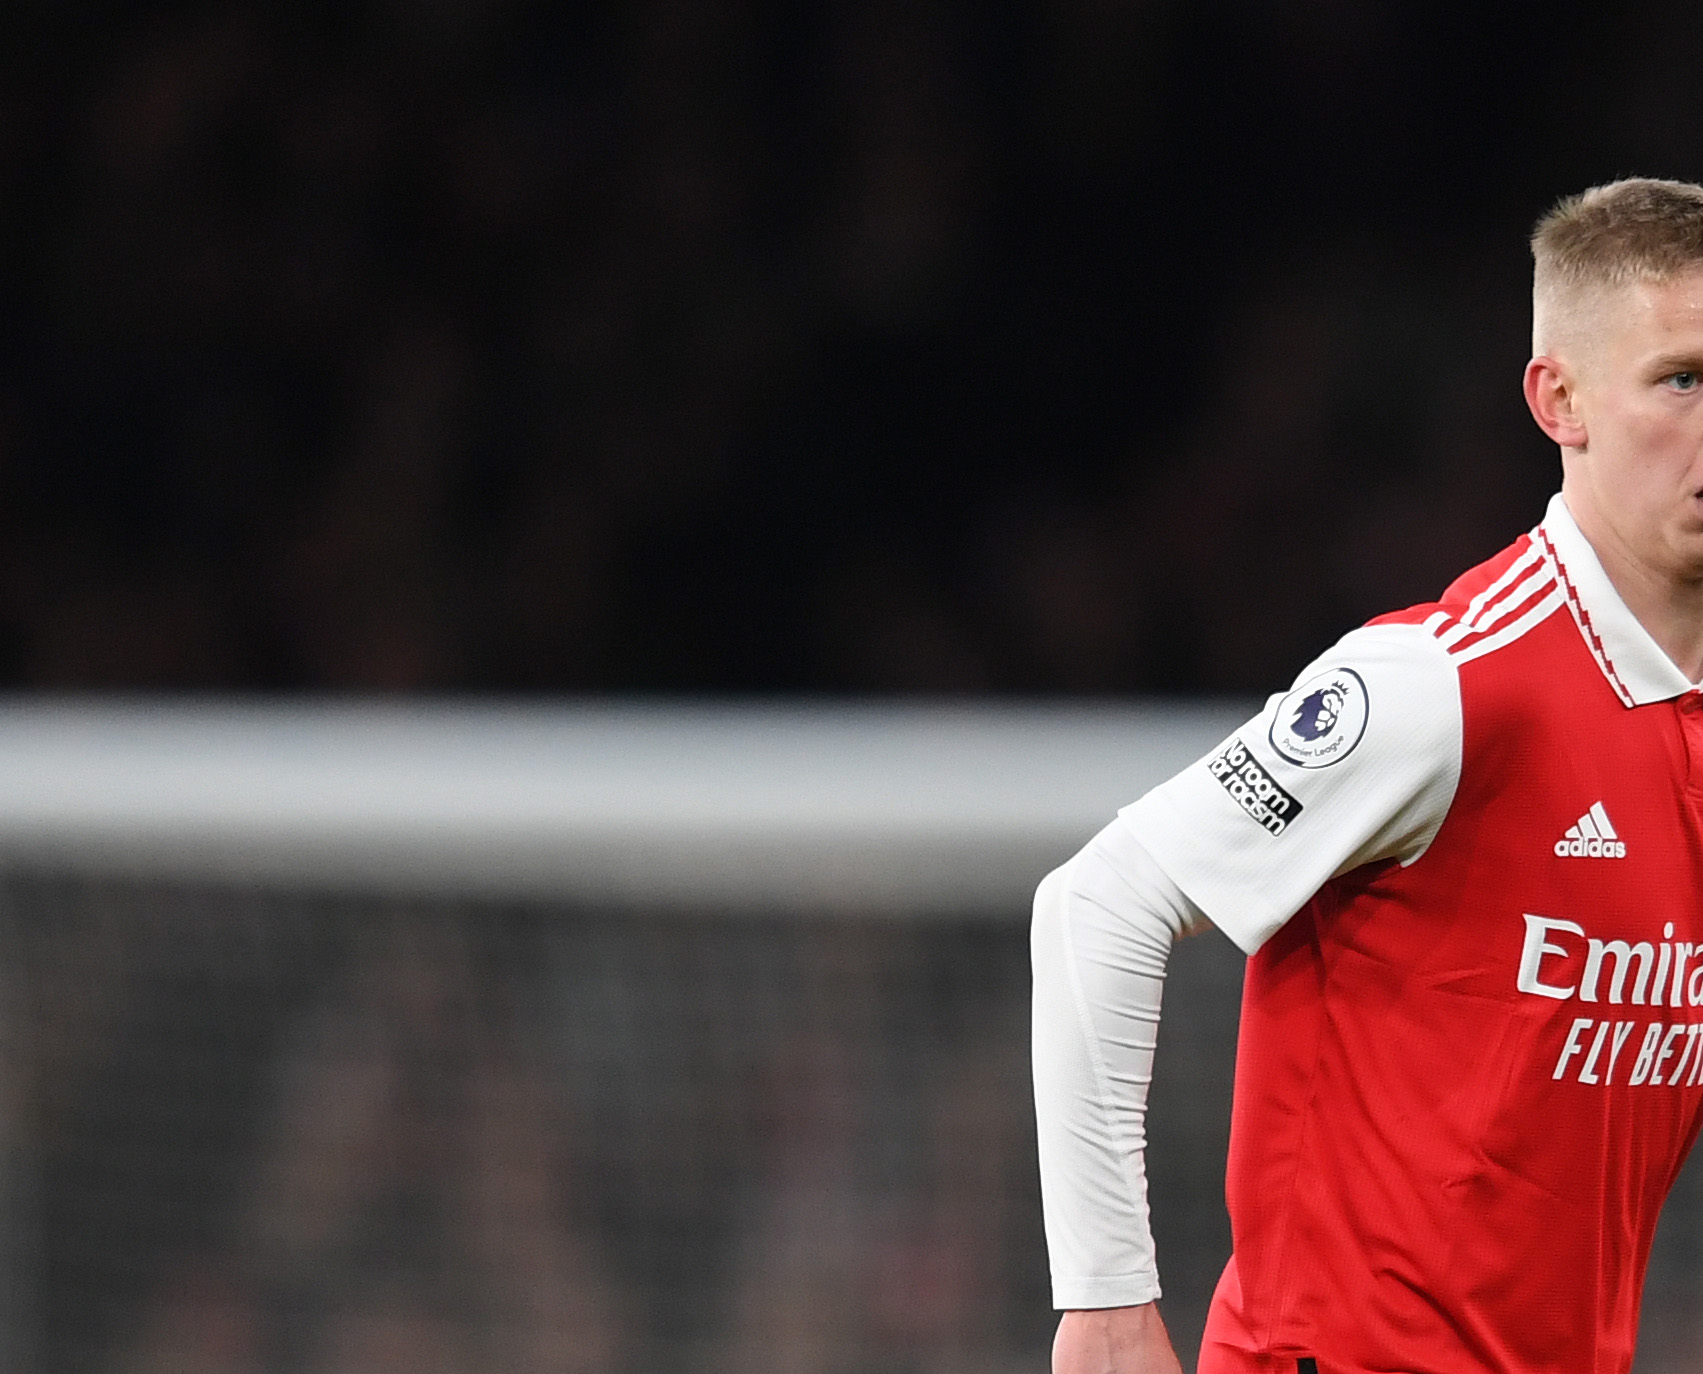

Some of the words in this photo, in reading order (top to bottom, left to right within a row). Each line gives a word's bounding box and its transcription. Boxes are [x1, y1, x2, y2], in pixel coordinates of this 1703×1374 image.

[1220, 738, 1247, 767] No
[1238, 761, 1290, 815] room
[1282, 738, 1313, 756] Premier
[1314, 735, 1344, 757] League
[1222, 772, 1286, 836] racism
[1553, 836, 1627, 859] adidas
[1552, 1018, 1635, 1087] FLY
